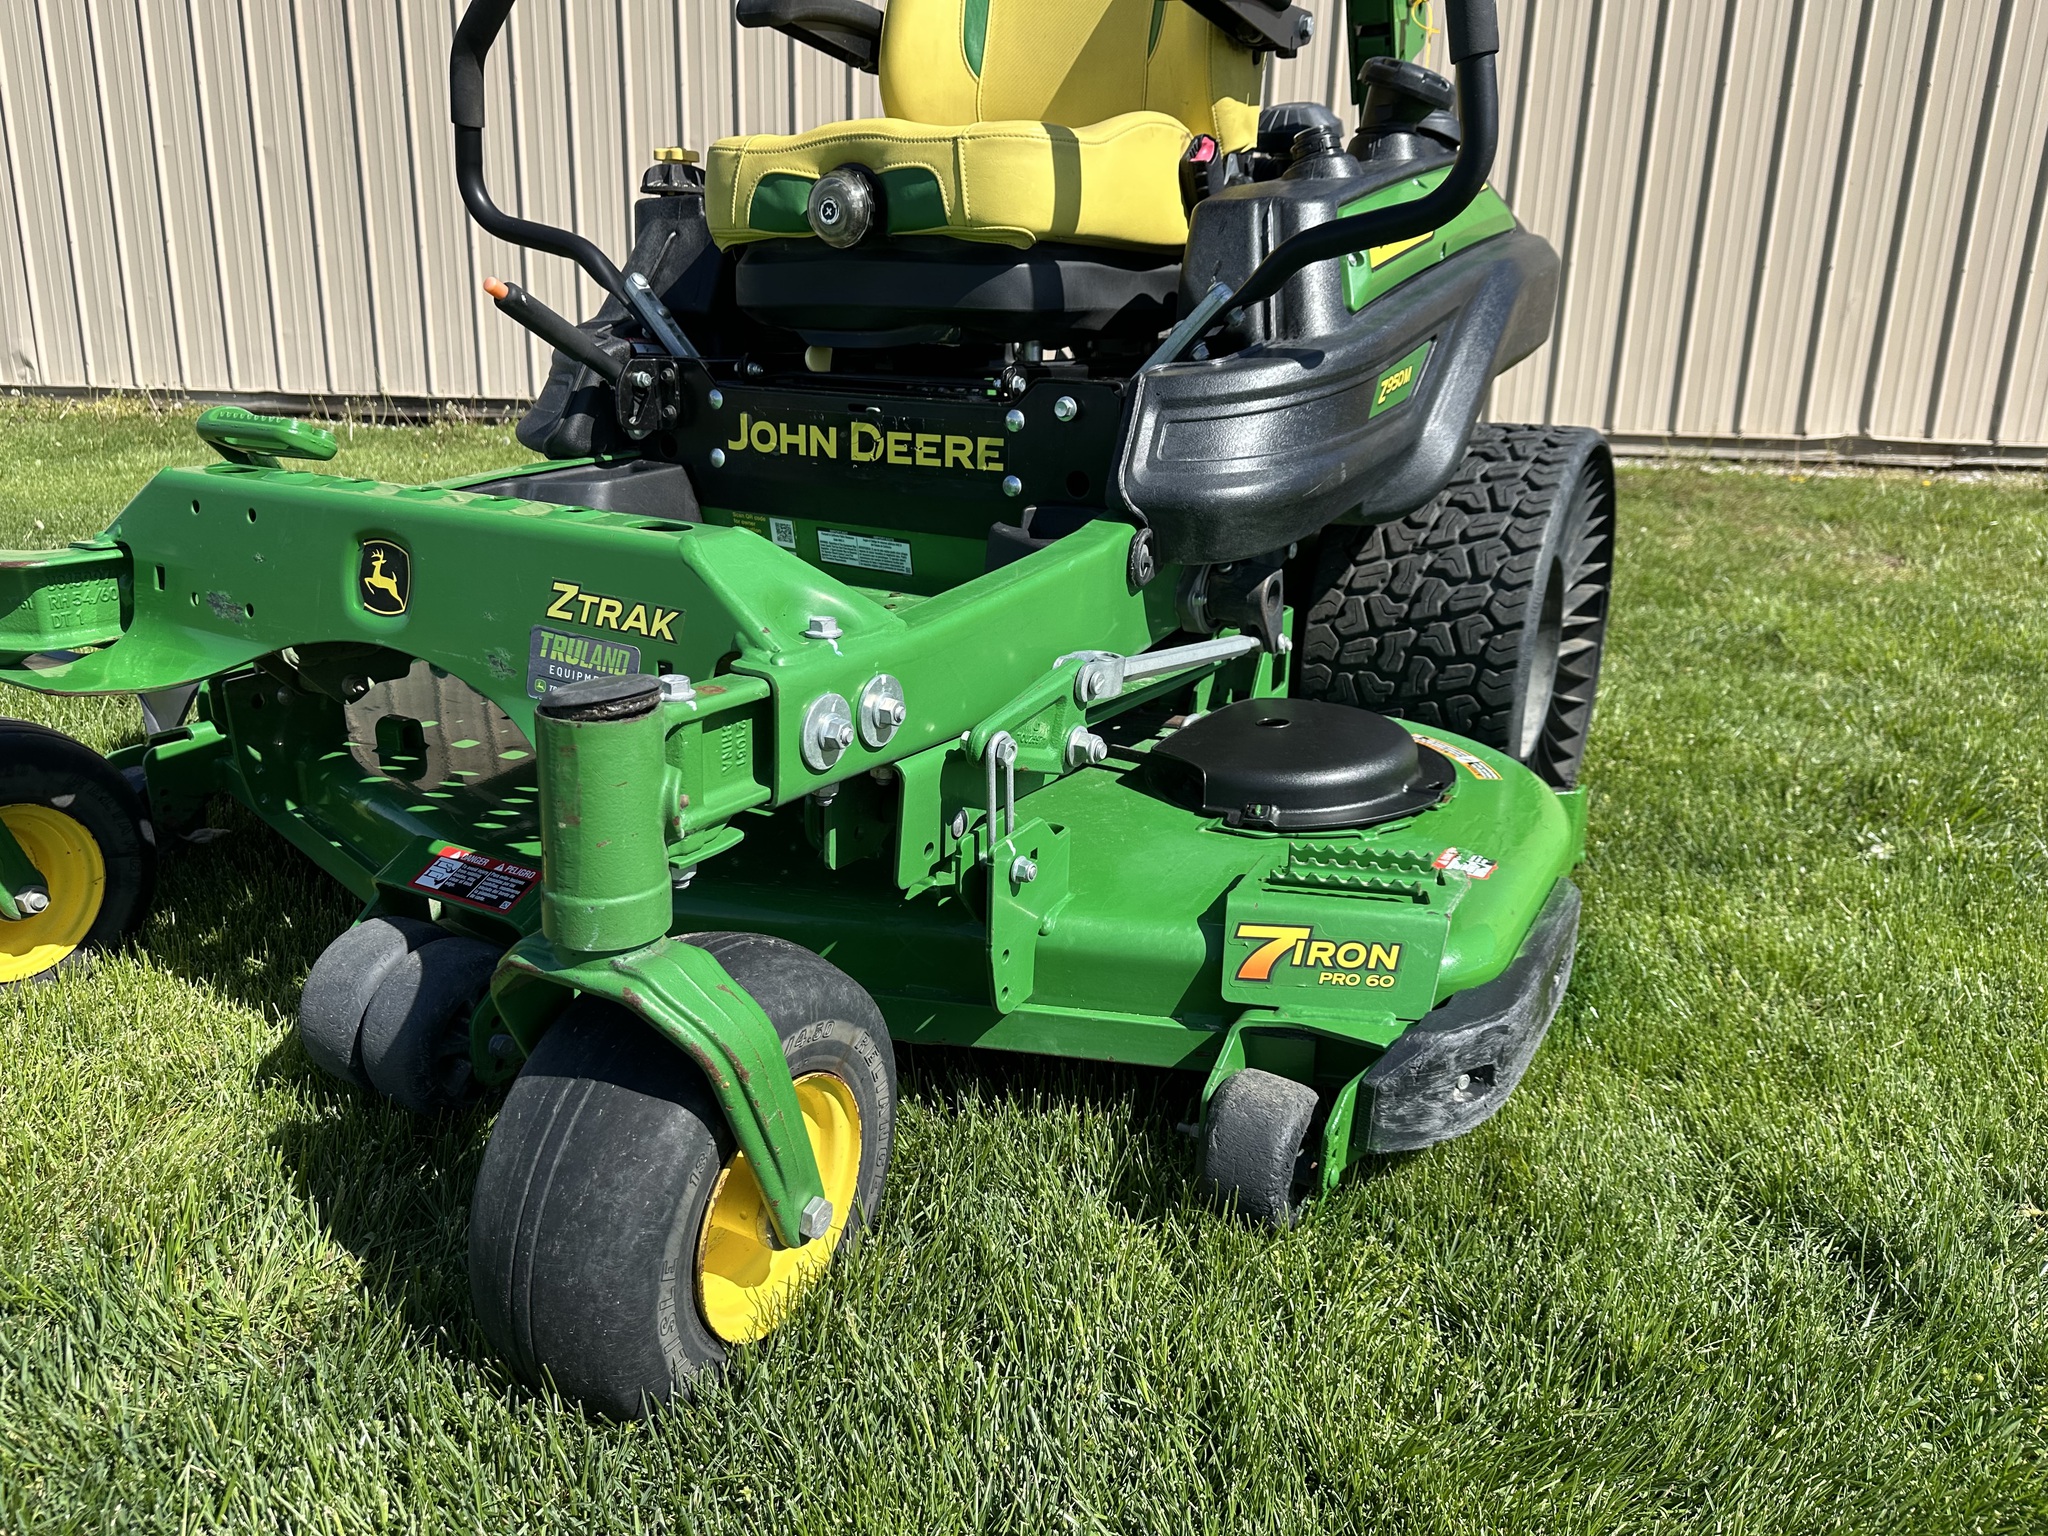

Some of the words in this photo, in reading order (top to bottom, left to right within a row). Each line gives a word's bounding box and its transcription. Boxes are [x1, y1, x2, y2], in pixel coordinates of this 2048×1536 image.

[1377, 365, 1413, 405] Z950M
[727, 411, 837, 459] JOHN
[851, 420, 1004, 472] DEERE
[48, 592, 70, 610] RH
[72, 586, 119, 607] 54/60
[546, 580, 682, 642] ZTRAK
[51, 611, 71, 629] DT
[539, 630, 631, 677] TRULAND
[549, 664, 600, 682] EQUIPM
[461, 852, 490, 867] DANGER
[504, 864, 537, 879] PELIGRO
[1318, 971, 1361, 987] PRO
[1365, 974, 1395, 989] 60
[854, 1030, 890, 1195] RELIANCE
